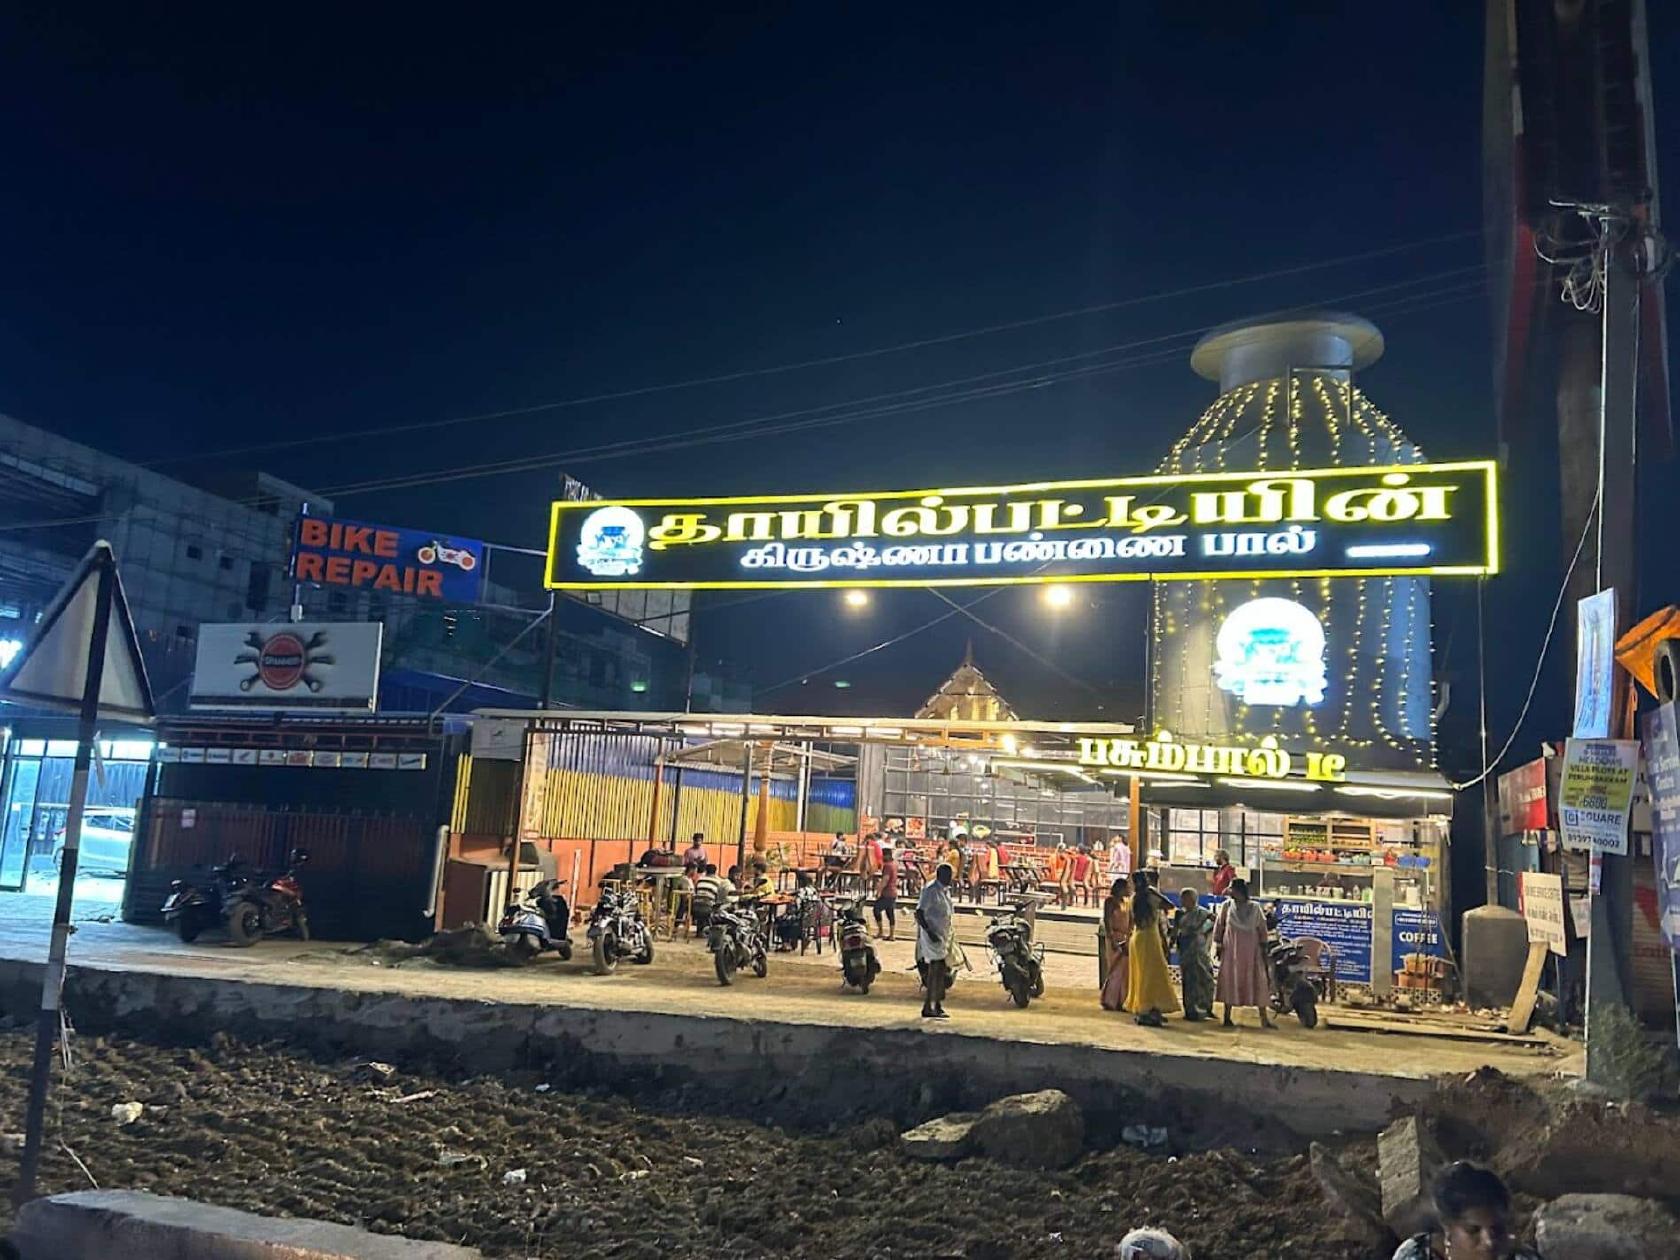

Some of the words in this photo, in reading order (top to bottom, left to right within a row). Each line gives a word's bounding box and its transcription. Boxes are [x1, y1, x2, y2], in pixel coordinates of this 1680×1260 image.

[648, 473, 1459, 550] தாயில்பட்டியின்
[301, 518, 400, 558] BIKE
[1203, 525, 1317, 558] பால்
[296, 552, 444, 599] REPAIR
[1076, 730, 1292, 779] பசும்பால்
[1305, 751, 1346, 782] டீ
[1580, 811, 1622, 825] SQUARE
